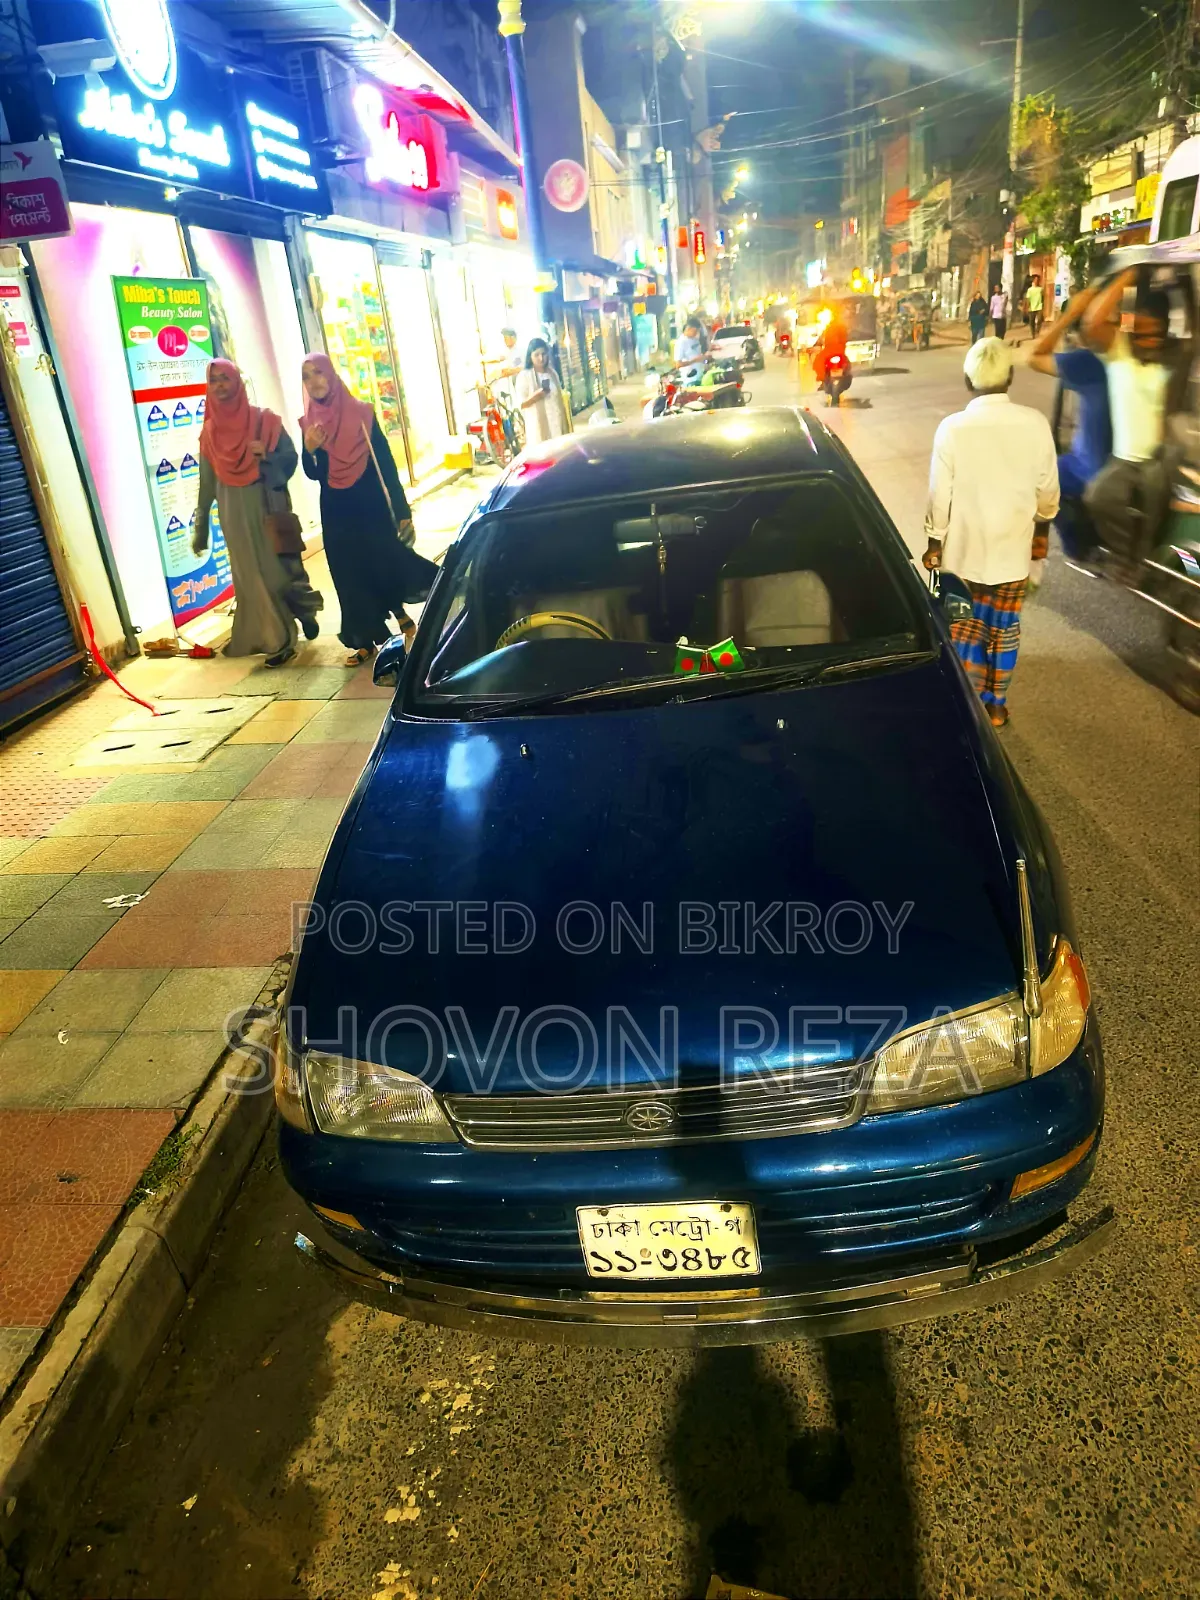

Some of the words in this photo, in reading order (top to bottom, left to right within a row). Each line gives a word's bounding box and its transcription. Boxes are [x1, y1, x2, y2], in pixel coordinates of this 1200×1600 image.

[167, 287, 201, 305] Touch
[141, 306, 175, 321] Beauty
[177, 306, 203, 318] Salon
[590, 1219, 641, 1239] ঢাকা
[590, 1247, 751, 1273] ১১-৩৪৮৫
